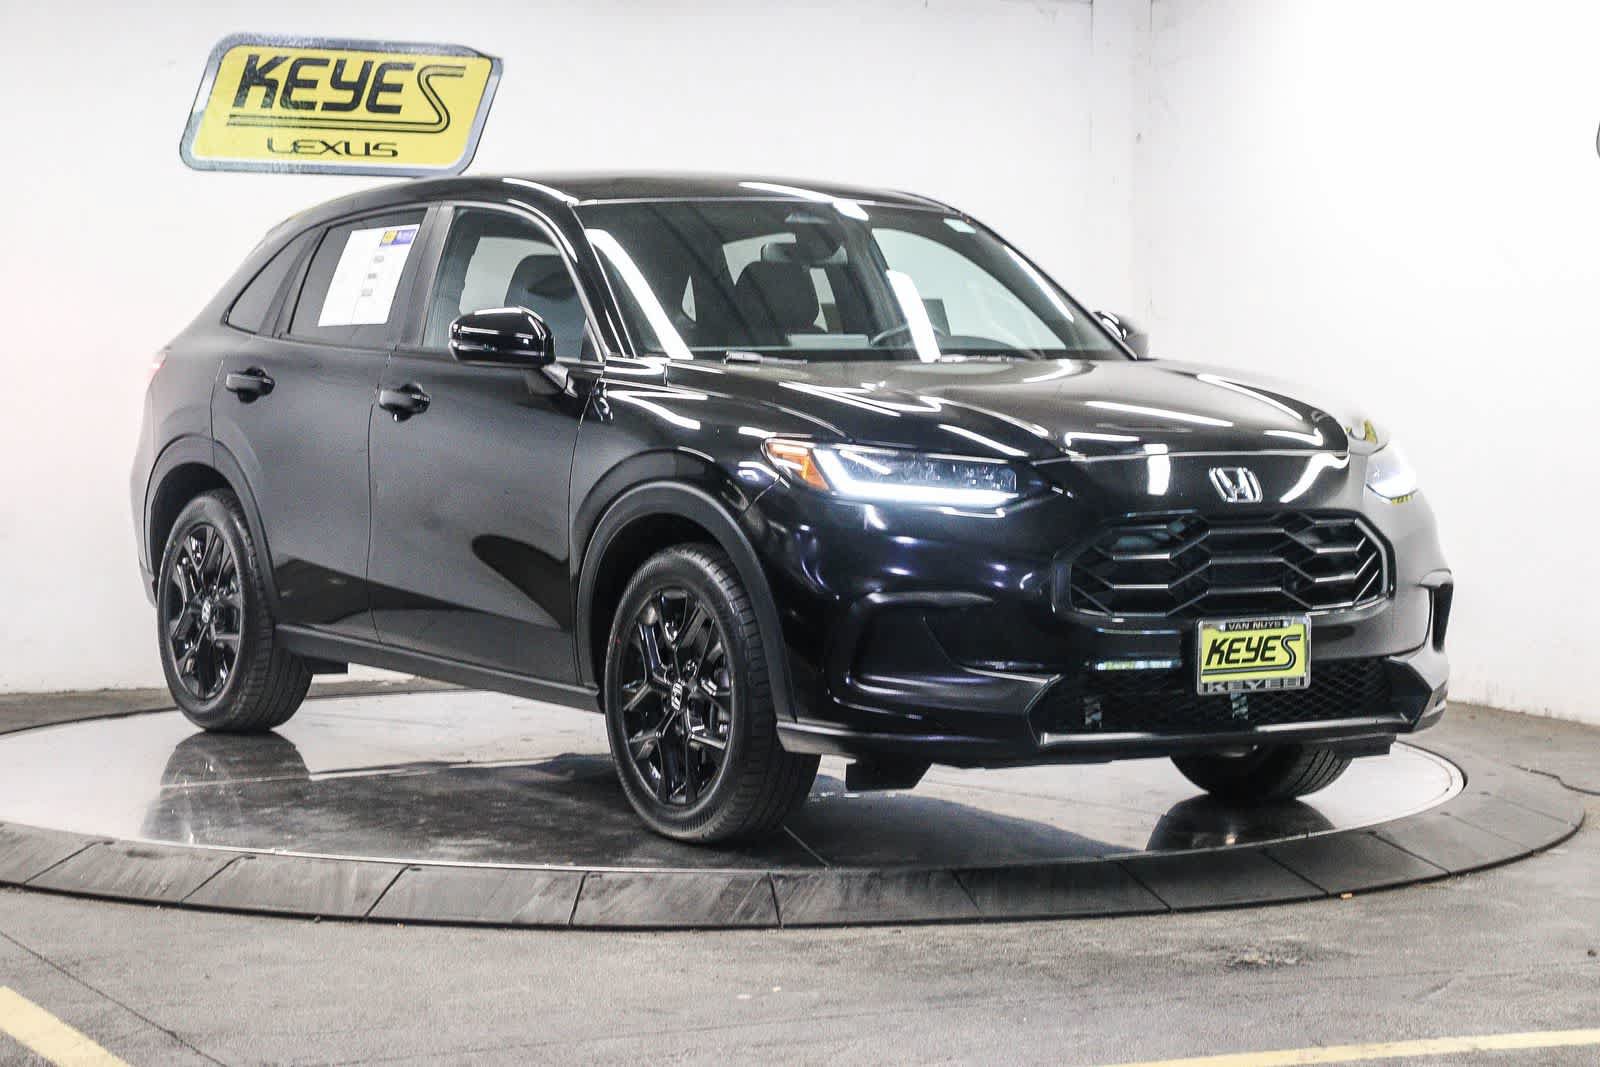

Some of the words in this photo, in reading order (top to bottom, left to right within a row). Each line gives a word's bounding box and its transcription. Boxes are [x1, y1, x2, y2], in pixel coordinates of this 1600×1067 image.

[228, 54, 467, 133] KEYES
[267, 137, 399, 158] LEXUS
[1228, 622, 1250, 631] VAN
[1202, 634, 1302, 676] KEYES
